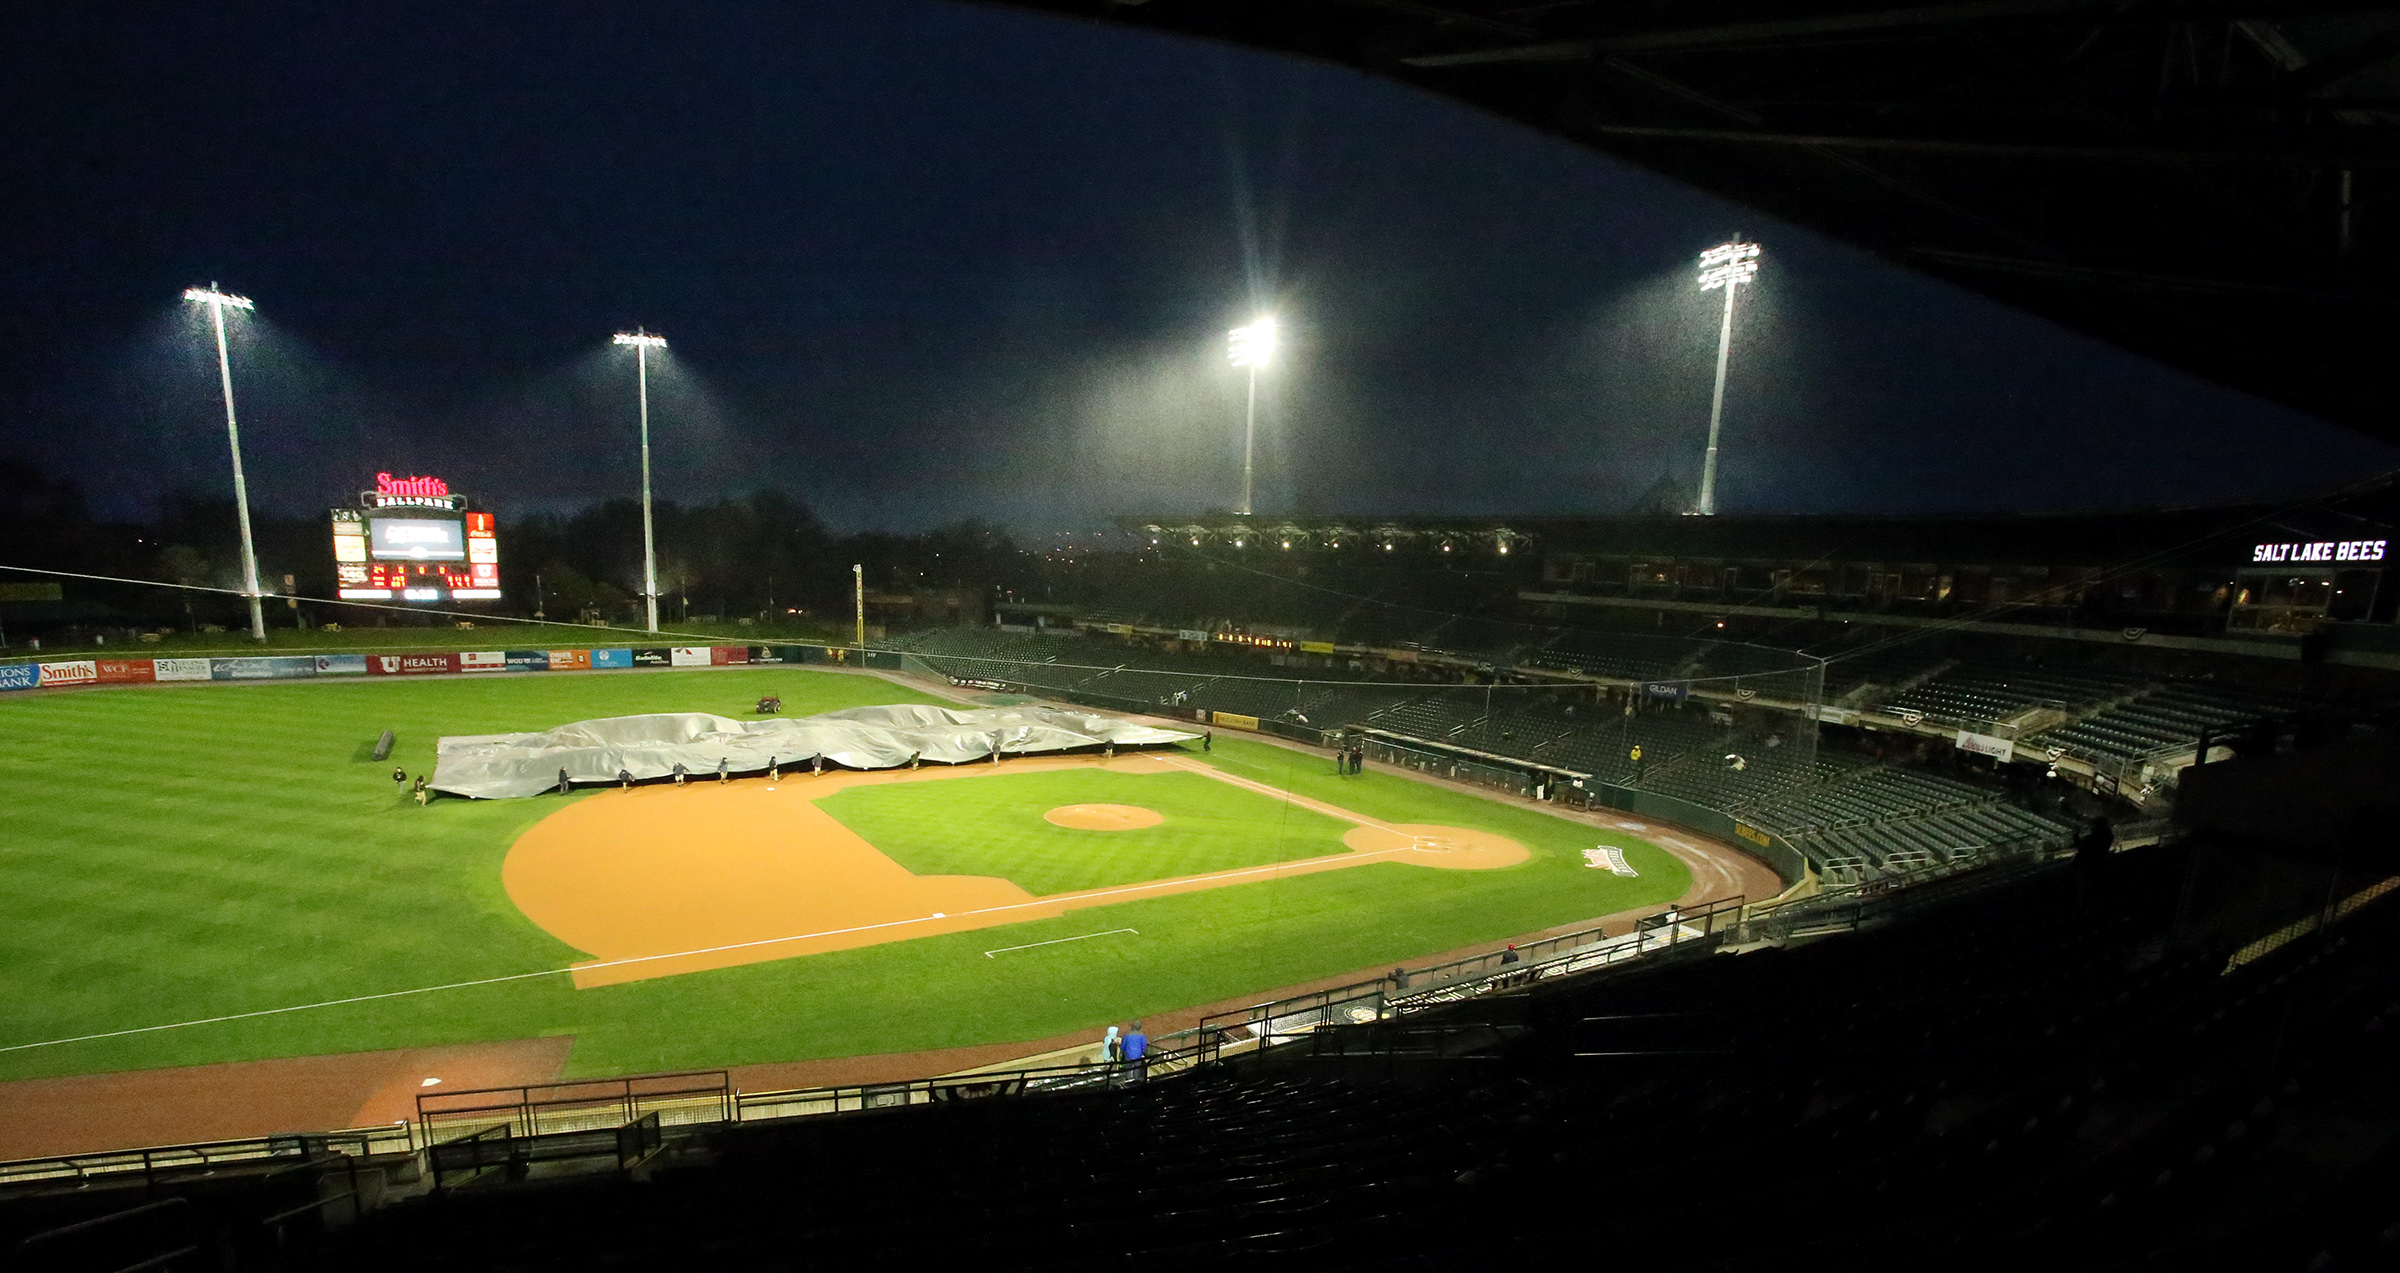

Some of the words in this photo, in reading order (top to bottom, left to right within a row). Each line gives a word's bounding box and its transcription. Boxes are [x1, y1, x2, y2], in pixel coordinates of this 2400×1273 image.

[376, 472, 449, 496] Smith's
[376, 496, 455, 510] BALLPARK
[2252, 544, 2291, 562] SALT
[2290, 542, 2336, 561] LAKE
[2335, 540, 2388, 560] BEES
[403, 658, 447, 668] HEALTH
[42, 664, 94, 680] Smith's
[1649, 684, 1678, 695] GILDAN
[1984, 745, 2007, 757] LIGHT
